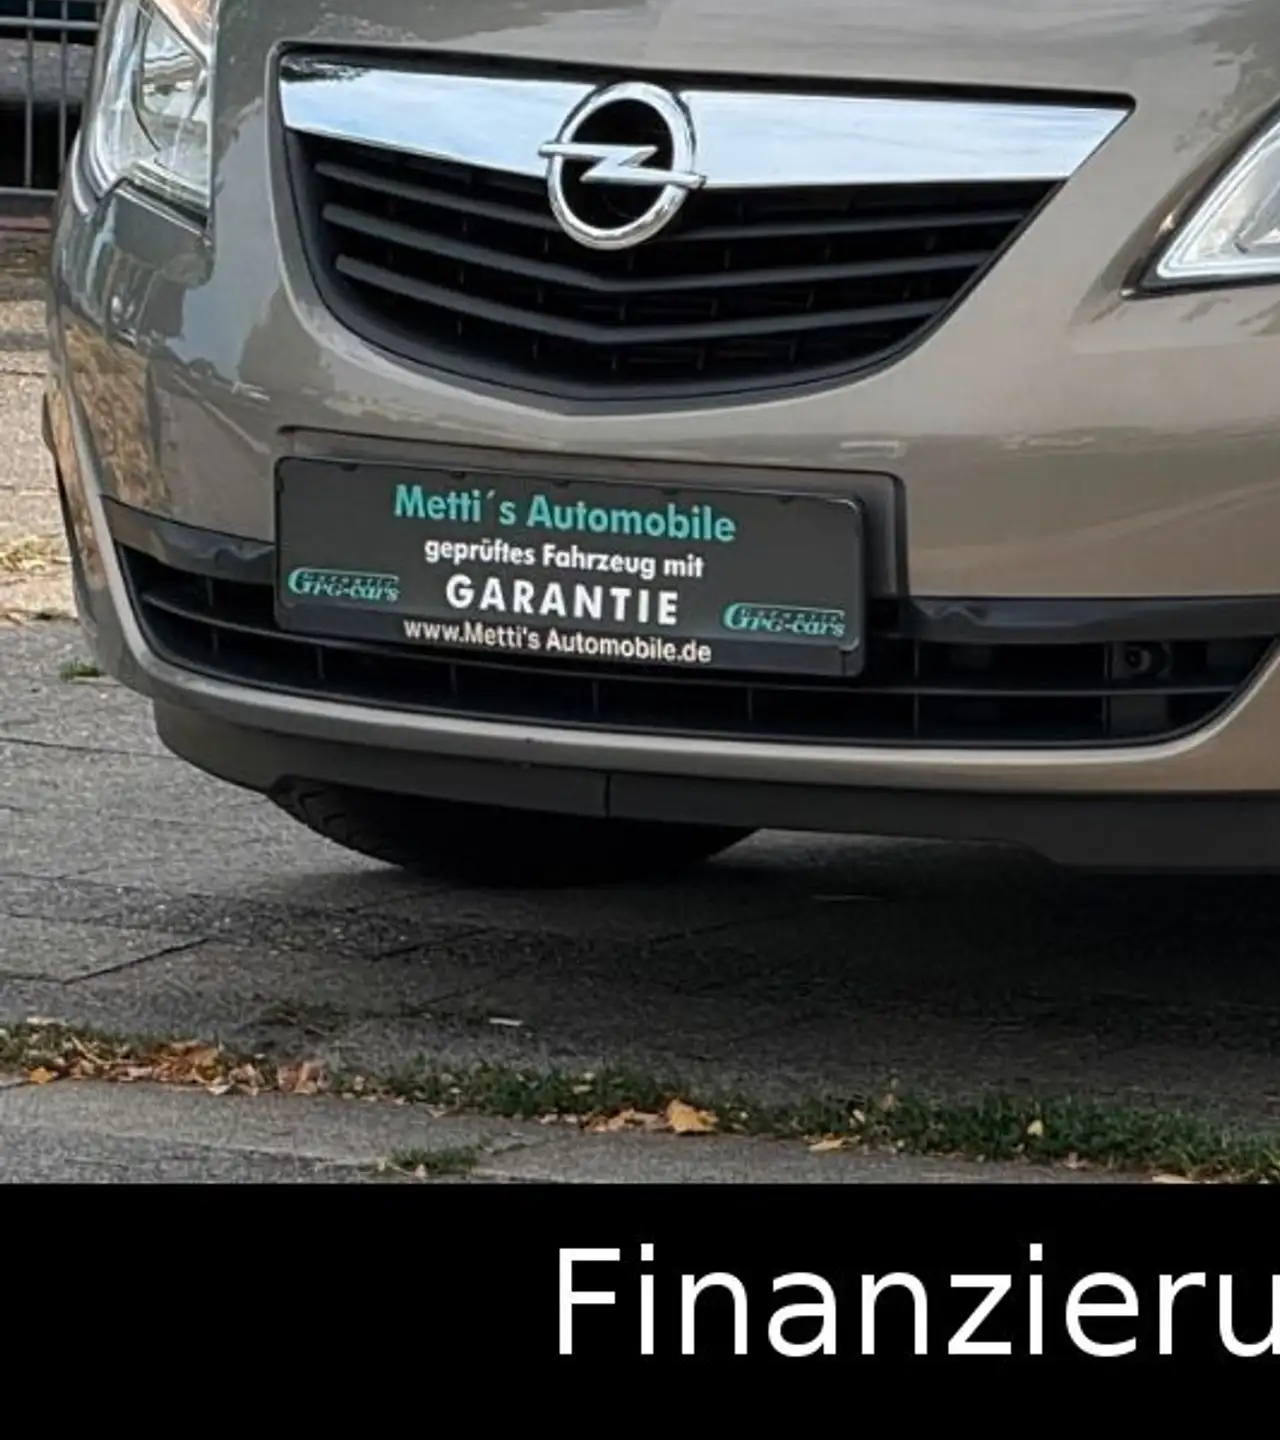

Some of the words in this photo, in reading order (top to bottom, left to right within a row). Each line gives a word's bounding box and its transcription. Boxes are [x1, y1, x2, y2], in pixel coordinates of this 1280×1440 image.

[526, 494, 736, 542] Automobile
[424, 537, 536, 566] geprüftes
[542, 543, 656, 580] Fahrzeug
[663, 553, 704, 578] mit
[446, 573, 678, 625] GARANTIE
[403, 619, 541, 651] www.Metti's
[545, 627, 712, 662] Automobile.de
